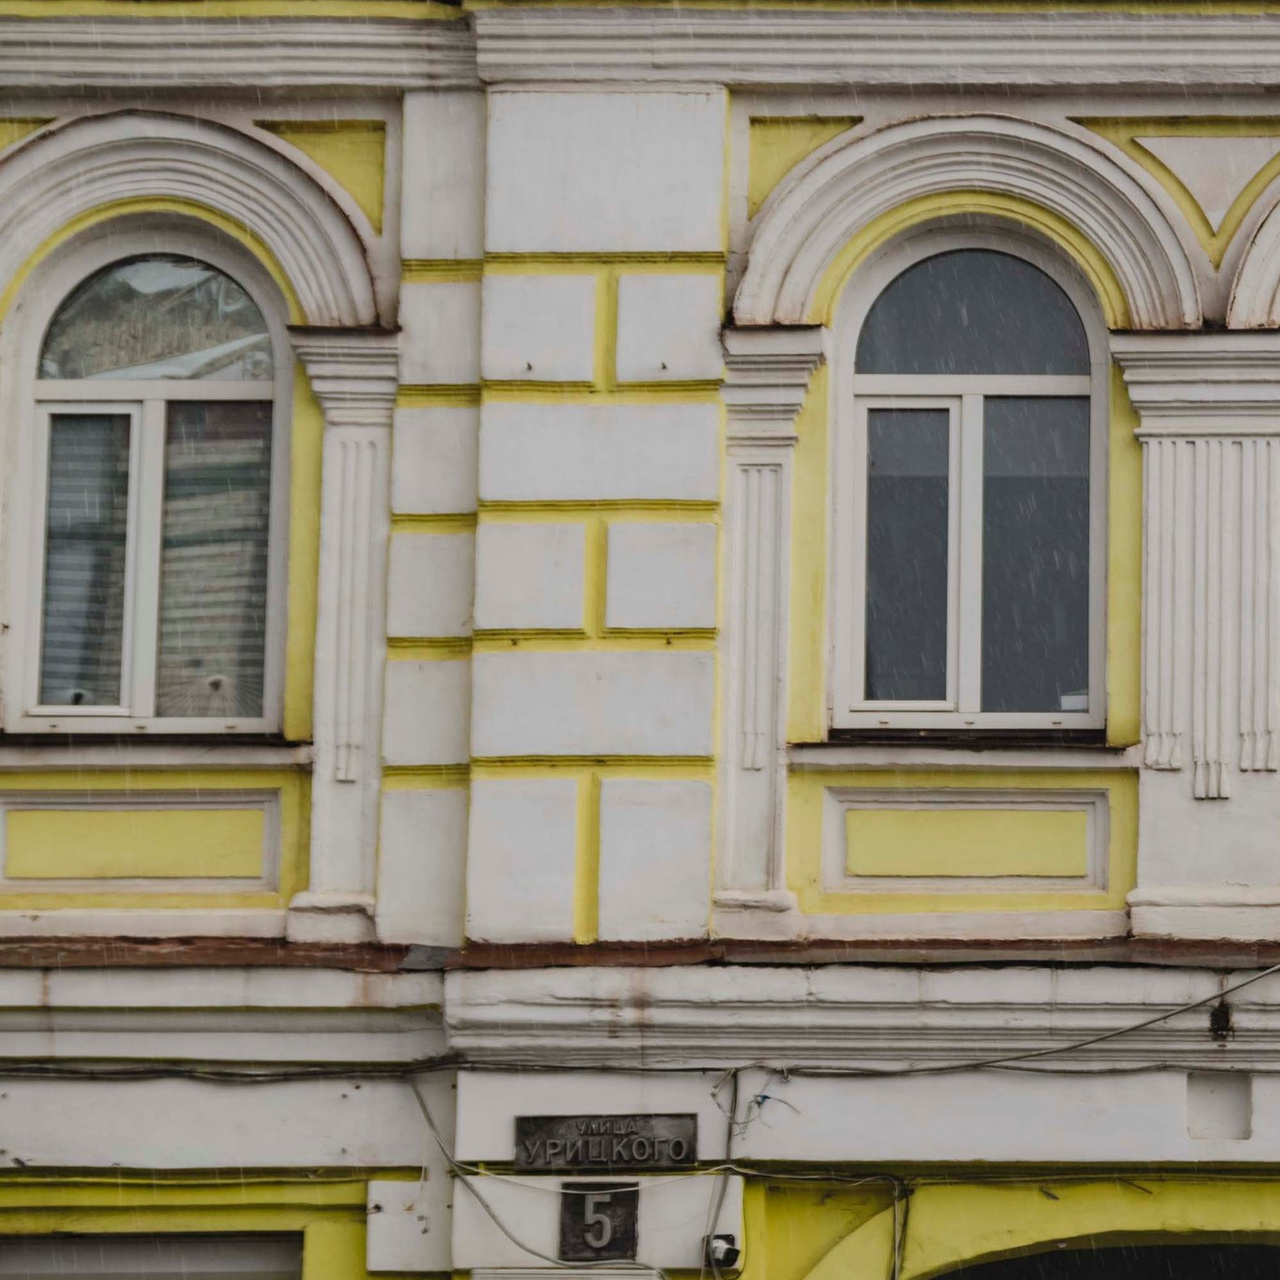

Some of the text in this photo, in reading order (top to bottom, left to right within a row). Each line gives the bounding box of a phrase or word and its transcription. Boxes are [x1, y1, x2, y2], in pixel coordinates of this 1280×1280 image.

[575, 1120, 639, 1136] УЛИЦА
[524, 1136, 687, 1163] УРИЦКОГО
[584, 1193, 612, 1248] 5
